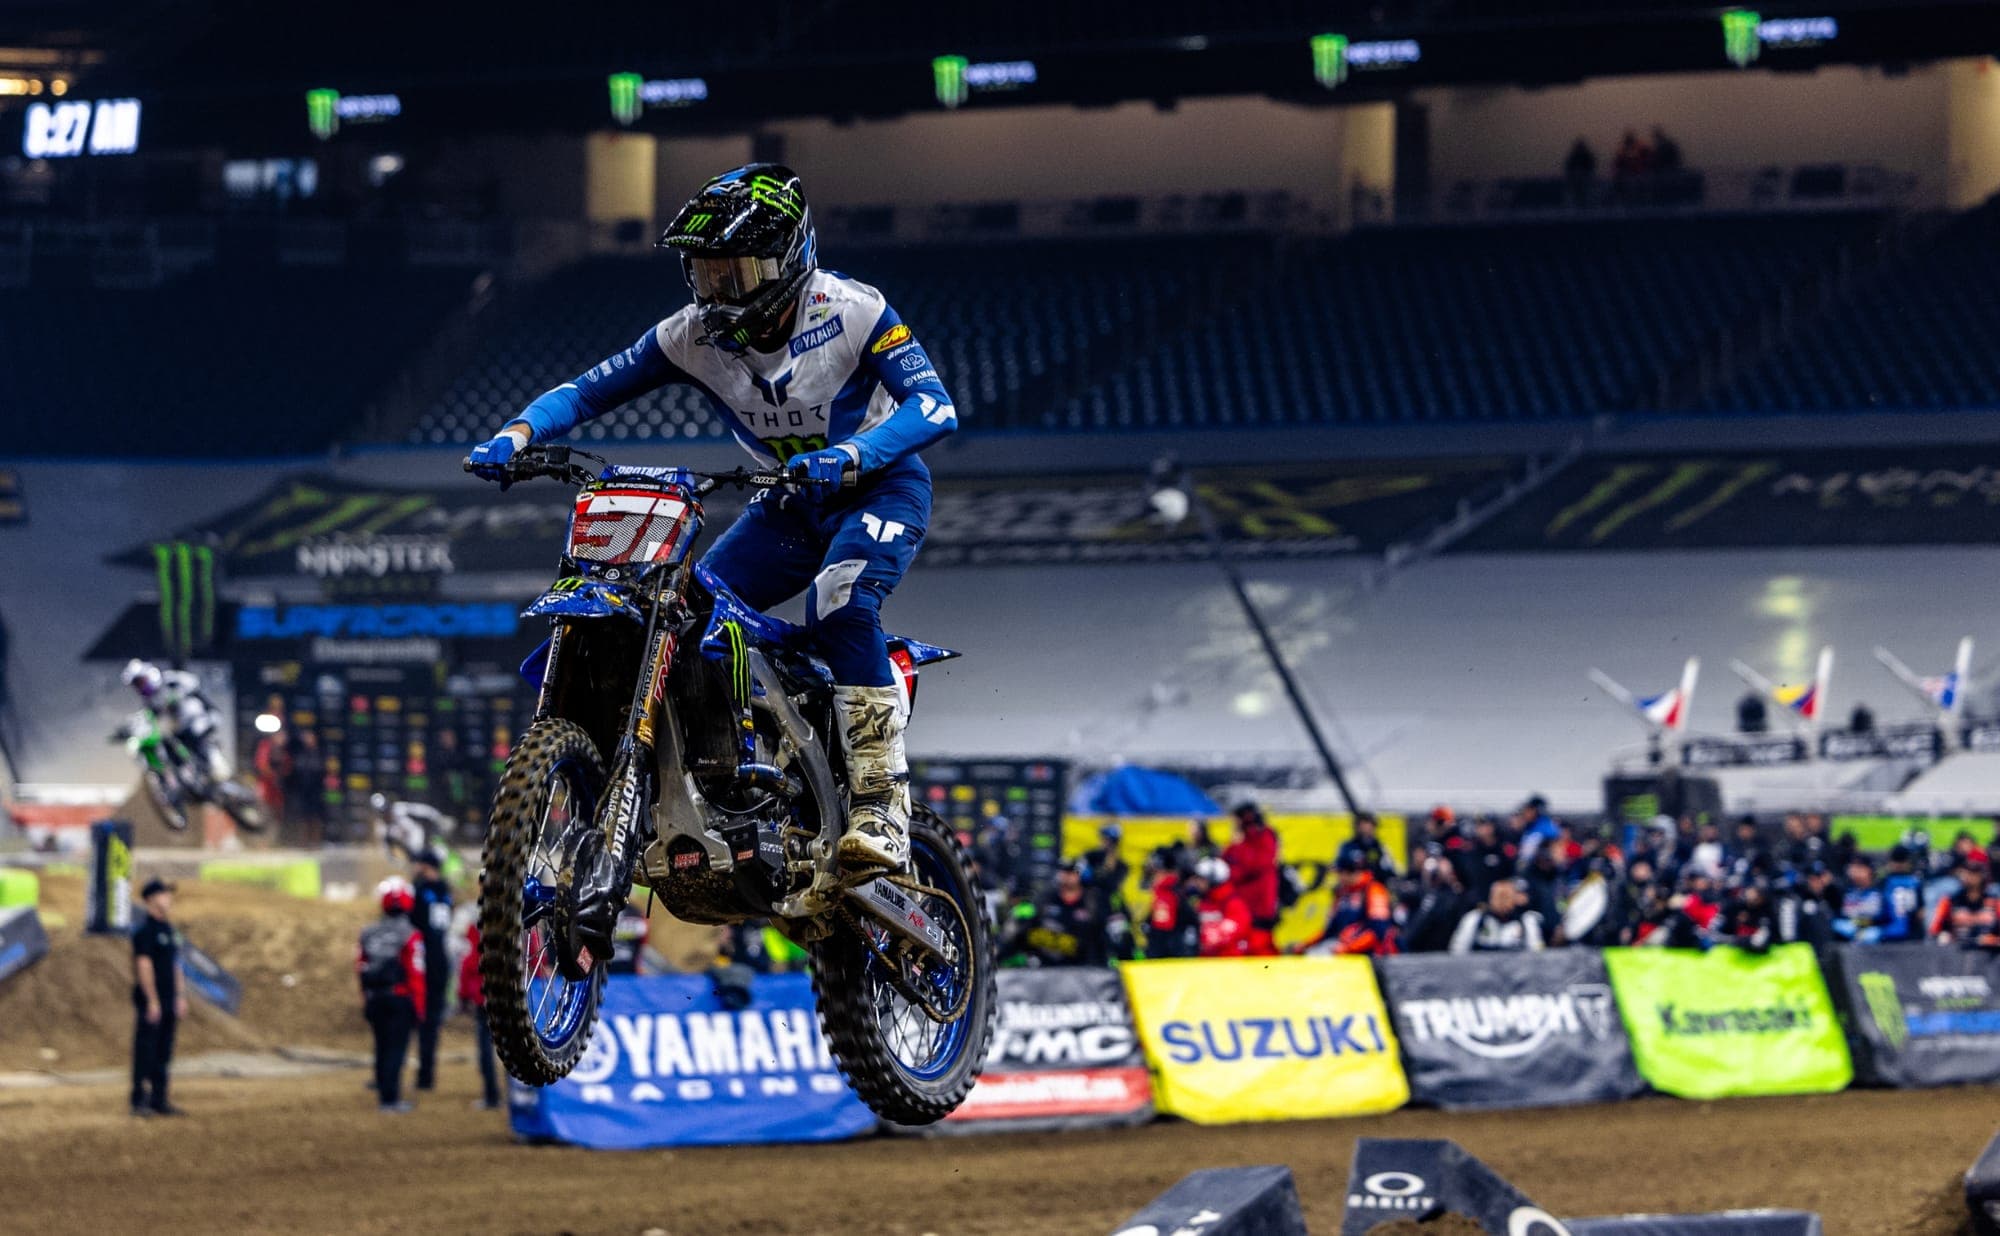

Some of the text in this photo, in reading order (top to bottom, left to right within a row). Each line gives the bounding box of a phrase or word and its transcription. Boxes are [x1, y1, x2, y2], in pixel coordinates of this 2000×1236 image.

[802, 319, 841, 349] YAMAHA
[740, 404, 826, 428] THOR
[611, 765, 638, 861] DUNLOP
[1160, 1014, 1387, 1065] SUZUKI
[1400, 992, 1580, 1045] TRIUMPH
